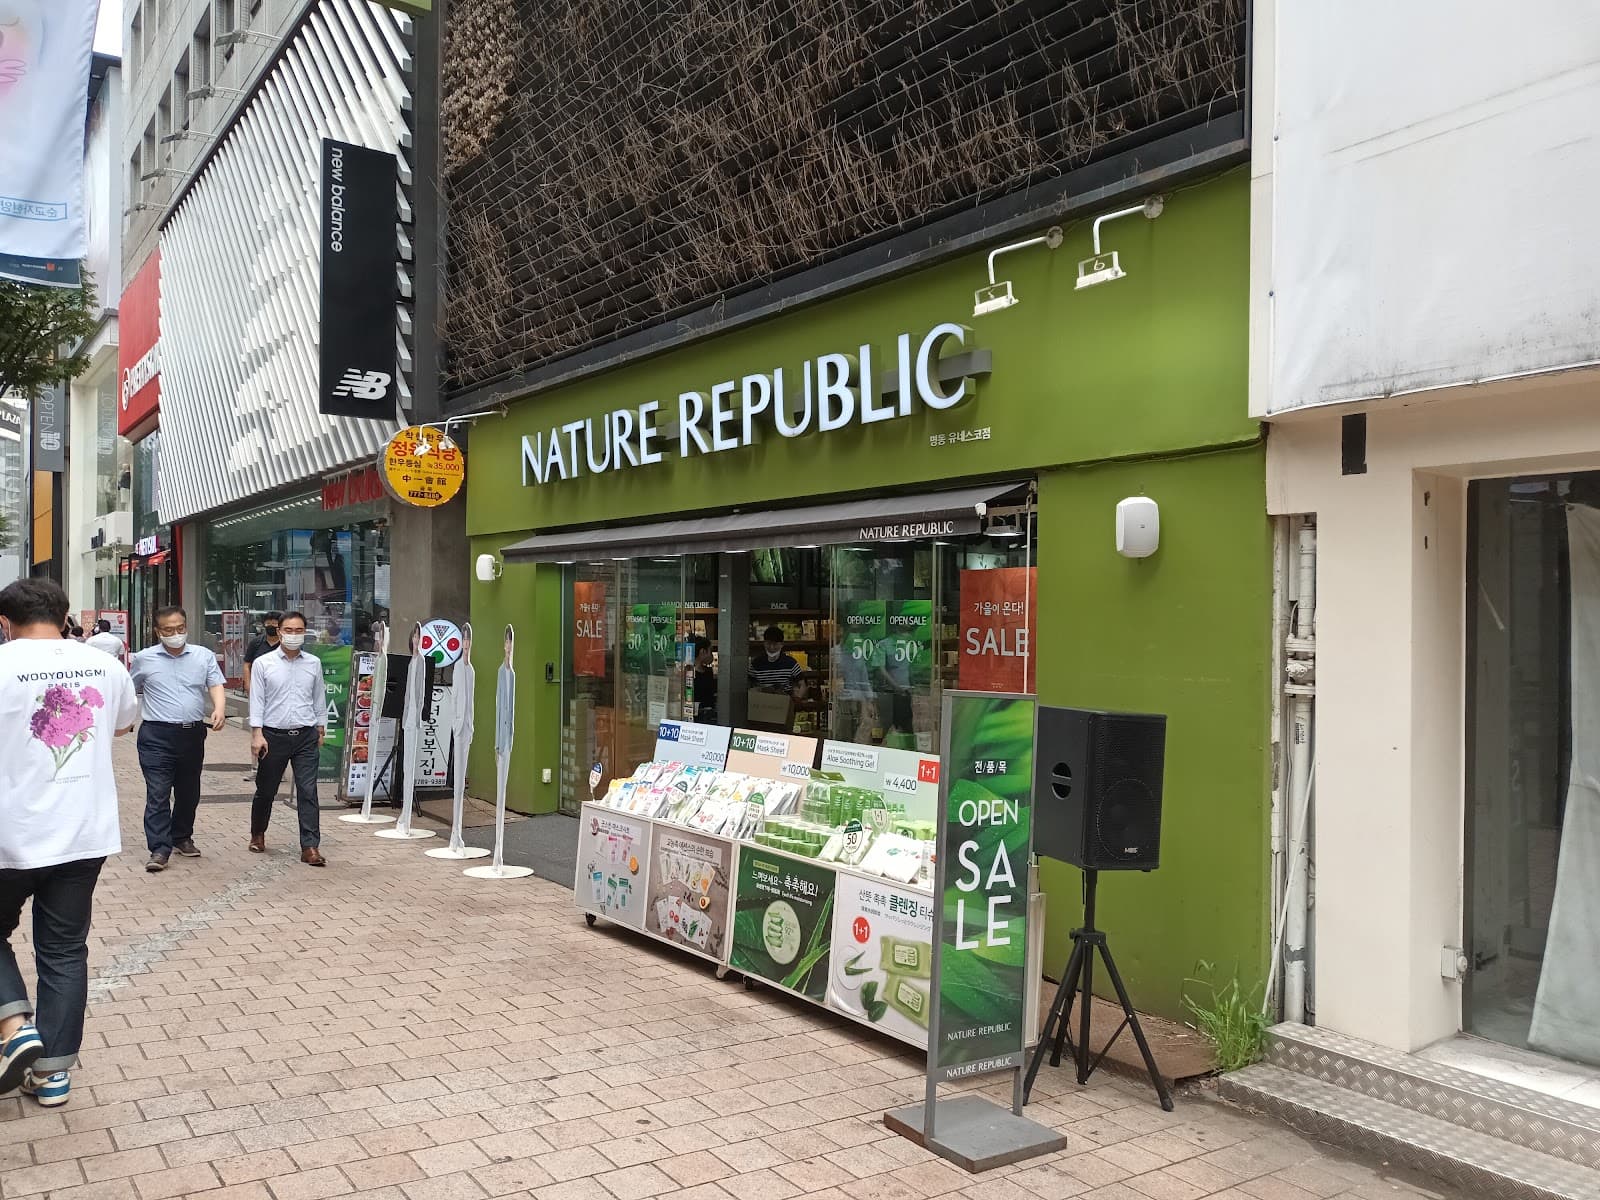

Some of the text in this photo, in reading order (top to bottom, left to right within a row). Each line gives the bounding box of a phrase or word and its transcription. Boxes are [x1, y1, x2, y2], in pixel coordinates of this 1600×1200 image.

[331, 147, 346, 253] new balance
[521, 321, 968, 487] NATURE REPUBLIC
[929, 426, 991, 447] 명동 유네스코점
[859, 520, 955, 540] NATURE REPUBLIC
[973, 601, 1024, 616] 가을이 온다!
[576, 619, 603, 639] SALE
[846, 615, 881, 625] OPEN SALE
[889, 615, 928, 626] OPEN SALE
[966, 627, 1030, 657] SALE
[659, 726, 680, 740] 10+10
[732, 735, 756, 750] 10+10
[826, 754, 839, 762] Aloe
[839, 755, 864, 769] Soothing
[865, 760, 875, 768] Gel
[920, 764, 937, 780] 1+1
[958, 799, 1019, 827] OPEN
[888, 894, 919, 918] 클렌징
[853, 922, 869, 939] 1+1
[947, 1022, 1012, 1042] NATURE REPUBLIC
[946, 1056, 1012, 1079] NATURE REPUBLIC
